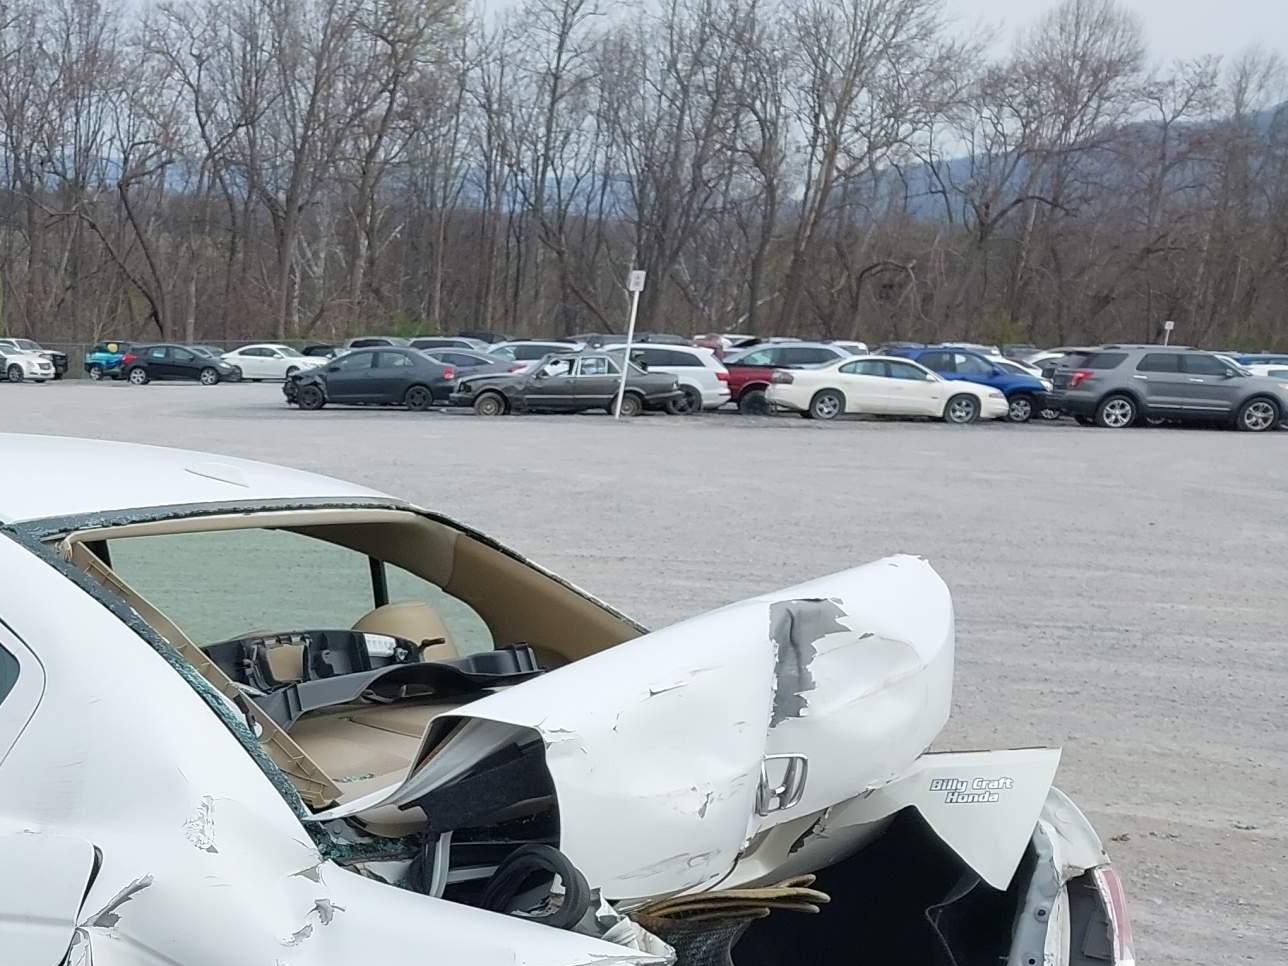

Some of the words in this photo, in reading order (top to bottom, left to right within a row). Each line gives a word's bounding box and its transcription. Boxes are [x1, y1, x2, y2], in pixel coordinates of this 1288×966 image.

[929, 778, 968, 793] Billy
[972, 777, 1014, 790] Craft
[944, 791, 999, 803] Honda
